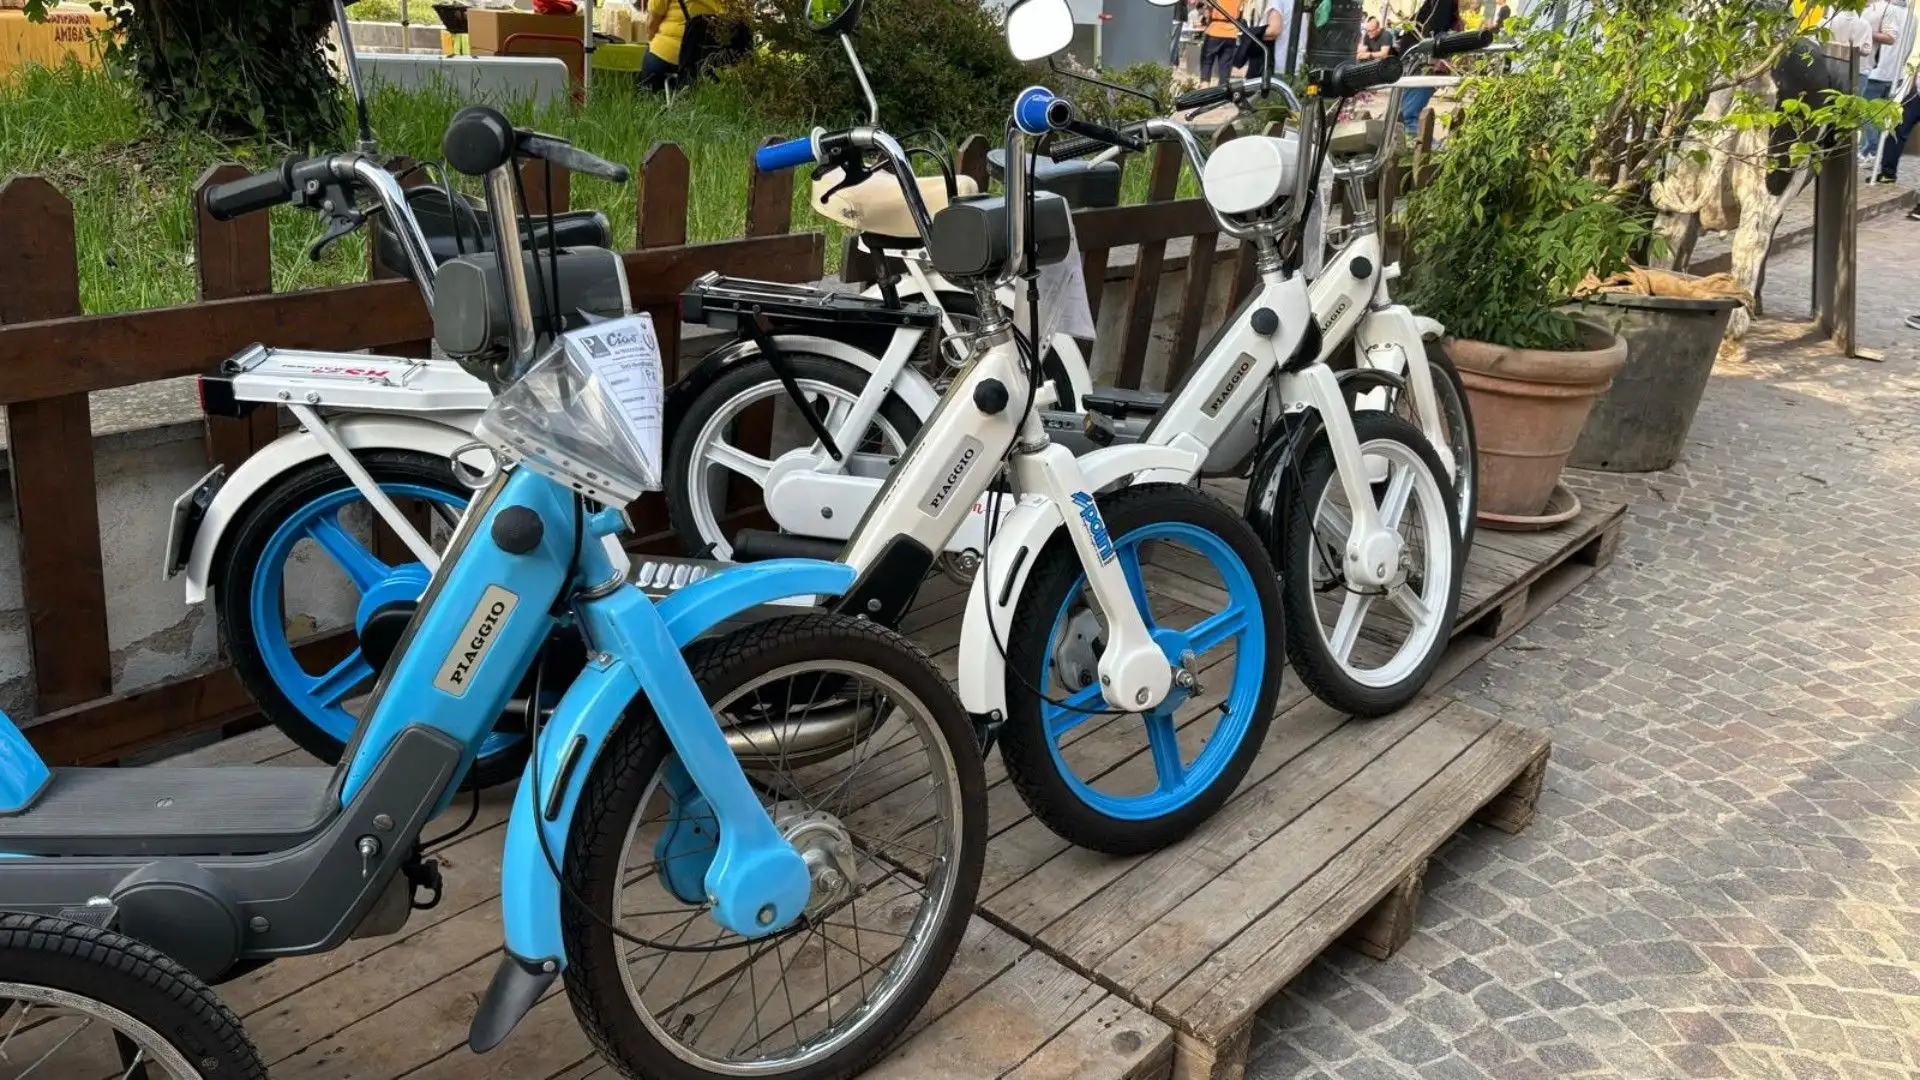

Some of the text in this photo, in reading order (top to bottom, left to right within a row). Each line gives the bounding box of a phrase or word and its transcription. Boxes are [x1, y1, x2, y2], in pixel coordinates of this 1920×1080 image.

[1321, 303, 1346, 331] AGGIO
[1211, 362, 1249, 410] PIAGGIO
[929, 448, 975, 509] PIAGGIO
[449, 601, 506, 685] PIAGGIO
